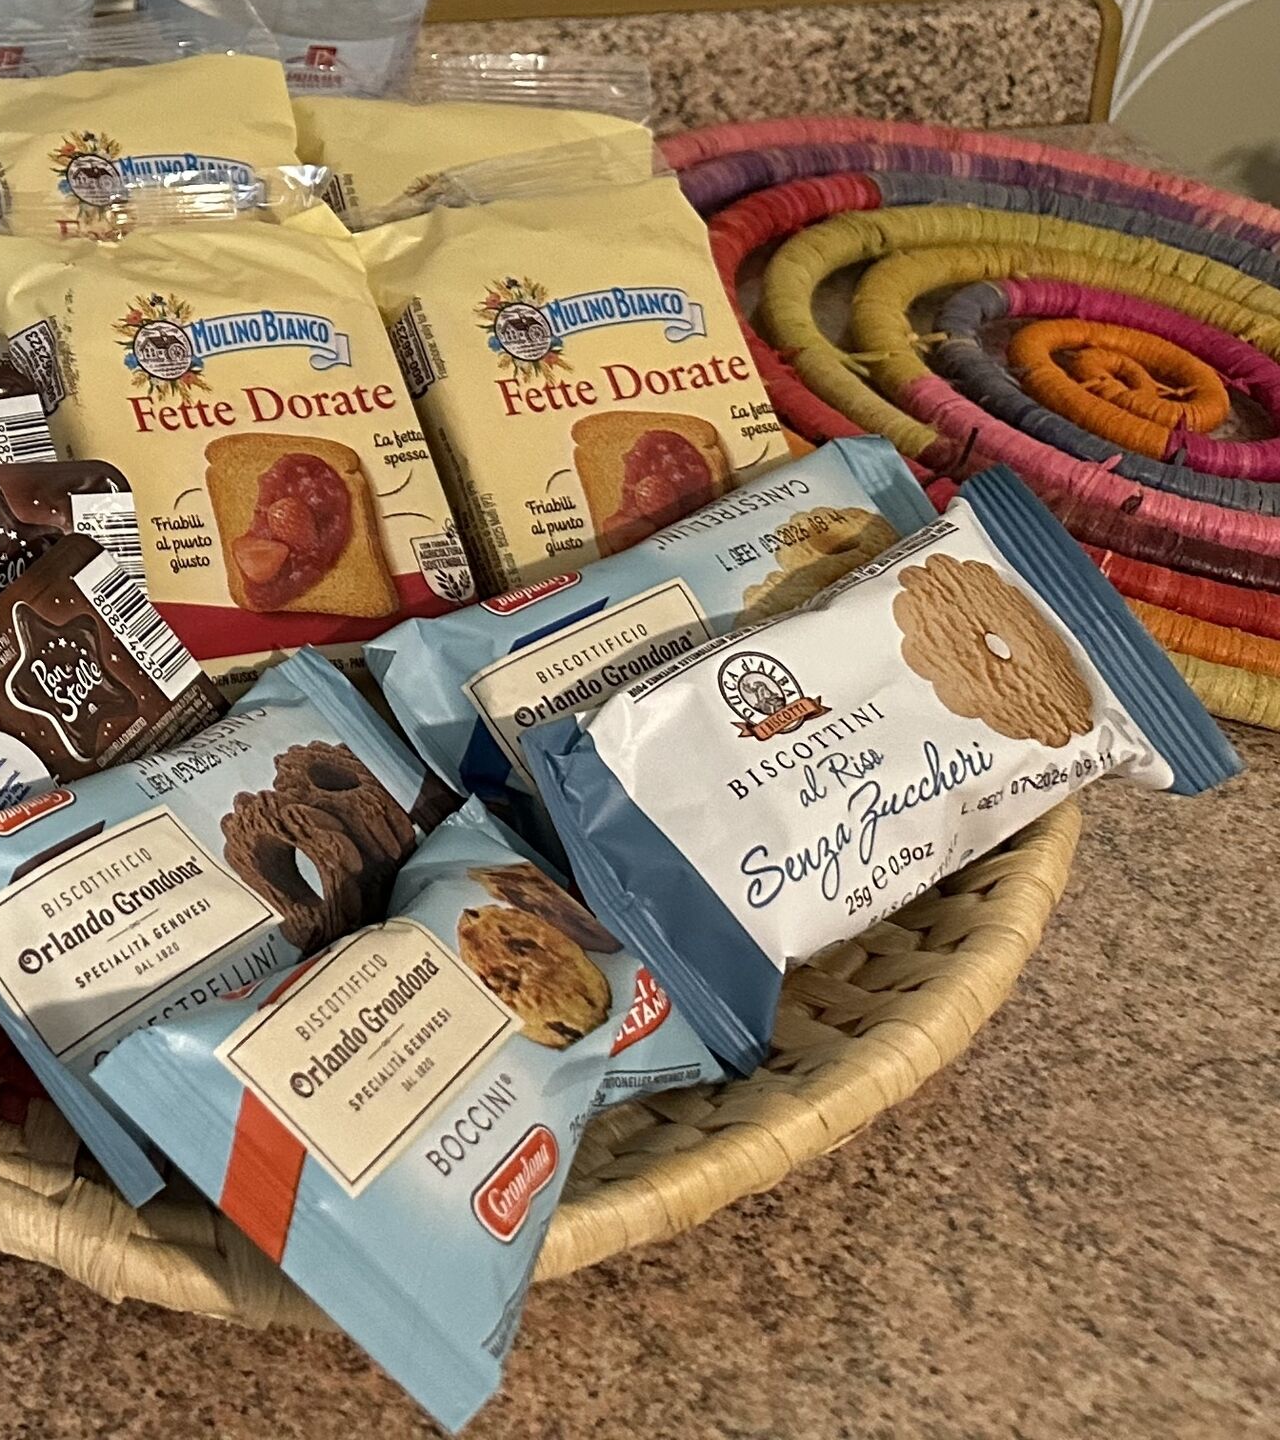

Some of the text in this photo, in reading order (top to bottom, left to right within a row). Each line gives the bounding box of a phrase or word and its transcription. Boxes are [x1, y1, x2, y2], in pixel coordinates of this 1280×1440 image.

[191, 309, 329, 352] MULINO BIANCO
[547, 287, 683, 332] MULINO BIANCO
[127, 384, 397, 433] Fette Dorate
[495, 355, 750, 416] Fette Dorate
[730, 404, 750, 420] La
[373, 432, 393, 448] La
[383, 449, 429, 467] spessa
[151, 514, 205, 532] Friabili
[525, 496, 576, 517] Friabili
[531, 517, 584, 538] al punto
[156, 534, 212, 555] al punto
[170, 553, 210, 574] giusto
[545, 536, 584, 558] giusto
[93, 594, 163, 680] 8085 4630
[536, 622, 648, 684] BISCOTTIFICIO
[31, 659, 71, 698] Pan
[52, 658, 102, 723] Stelle
[514, 678, 604, 728] Orlando
[601, 633, 694, 692] Grondona
[720, 670, 755, 720] DUCA
[767, 702, 809, 731] BISCOTTI
[727, 702, 884, 800] BISCOTTINI
[800, 745, 885, 808] al Riso
[740, 822, 852, 909] Senza
[847, 740, 994, 865] Zuccheri
[40, 846, 154, 918] BISCOTTIFICIO
[845, 841, 936, 917] 25g 0.9oz
[17, 901, 114, 975] Orlando
[112, 857, 203, 918] Grondona
[75, 899, 212, 989] SPECIALITÀ GENOVESI
[135, 941, 181, 976] DAL 1820
[295, 953, 388, 1041] BISCOTTIFICIO
[289, 1020, 367, 1098] Orlando
[358, 956, 441, 1039] Grondona
[348, 1008, 453, 1113] SPECIALITÀ GENOVESI
[401, 1055, 435, 1093] DAL 1820
[426, 1086, 519, 1177] BOCCINI
[488, 1142, 553, 1219] Grondona
